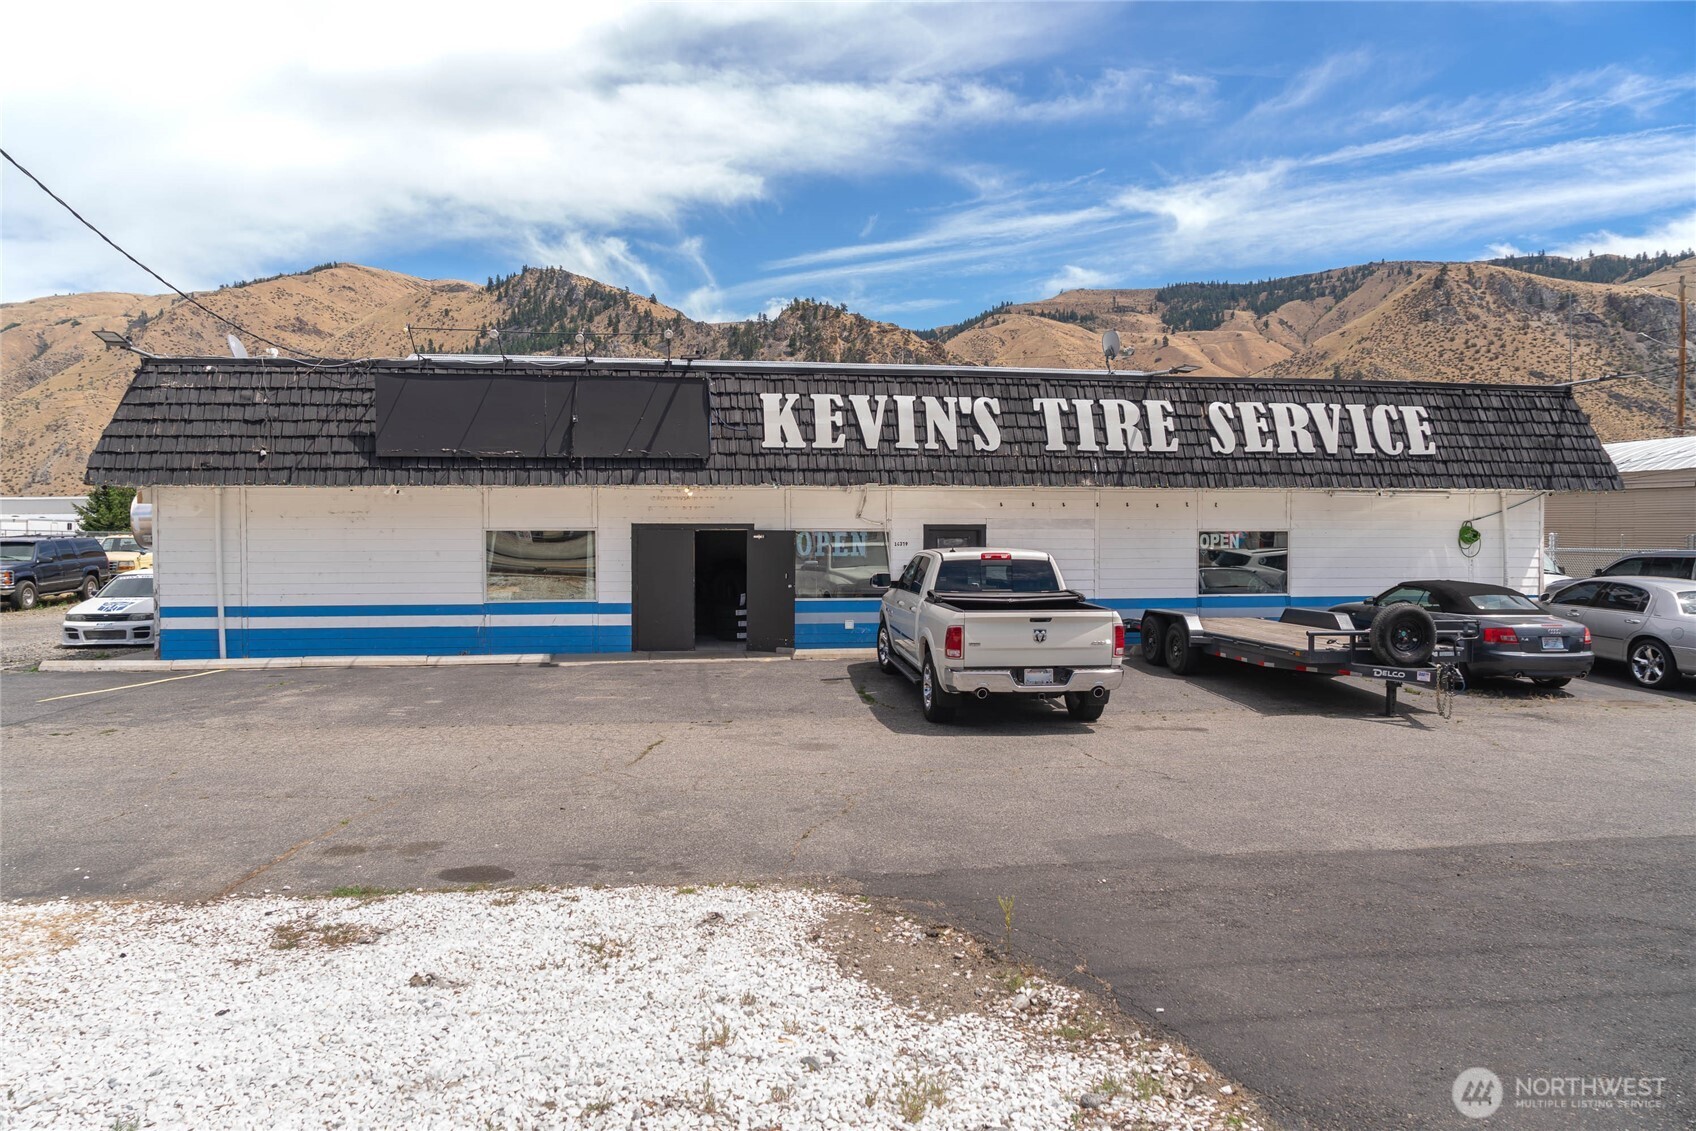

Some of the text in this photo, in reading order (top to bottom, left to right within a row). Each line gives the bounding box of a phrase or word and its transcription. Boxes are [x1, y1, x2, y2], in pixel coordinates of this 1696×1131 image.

[760, 393, 1436, 455] KEVIN'S TIRE SERVICE
[796, 531, 867, 556] OPEN
[1200, 533, 1240, 550] OPEN
[1373, 669, 1406, 678] DELCO
